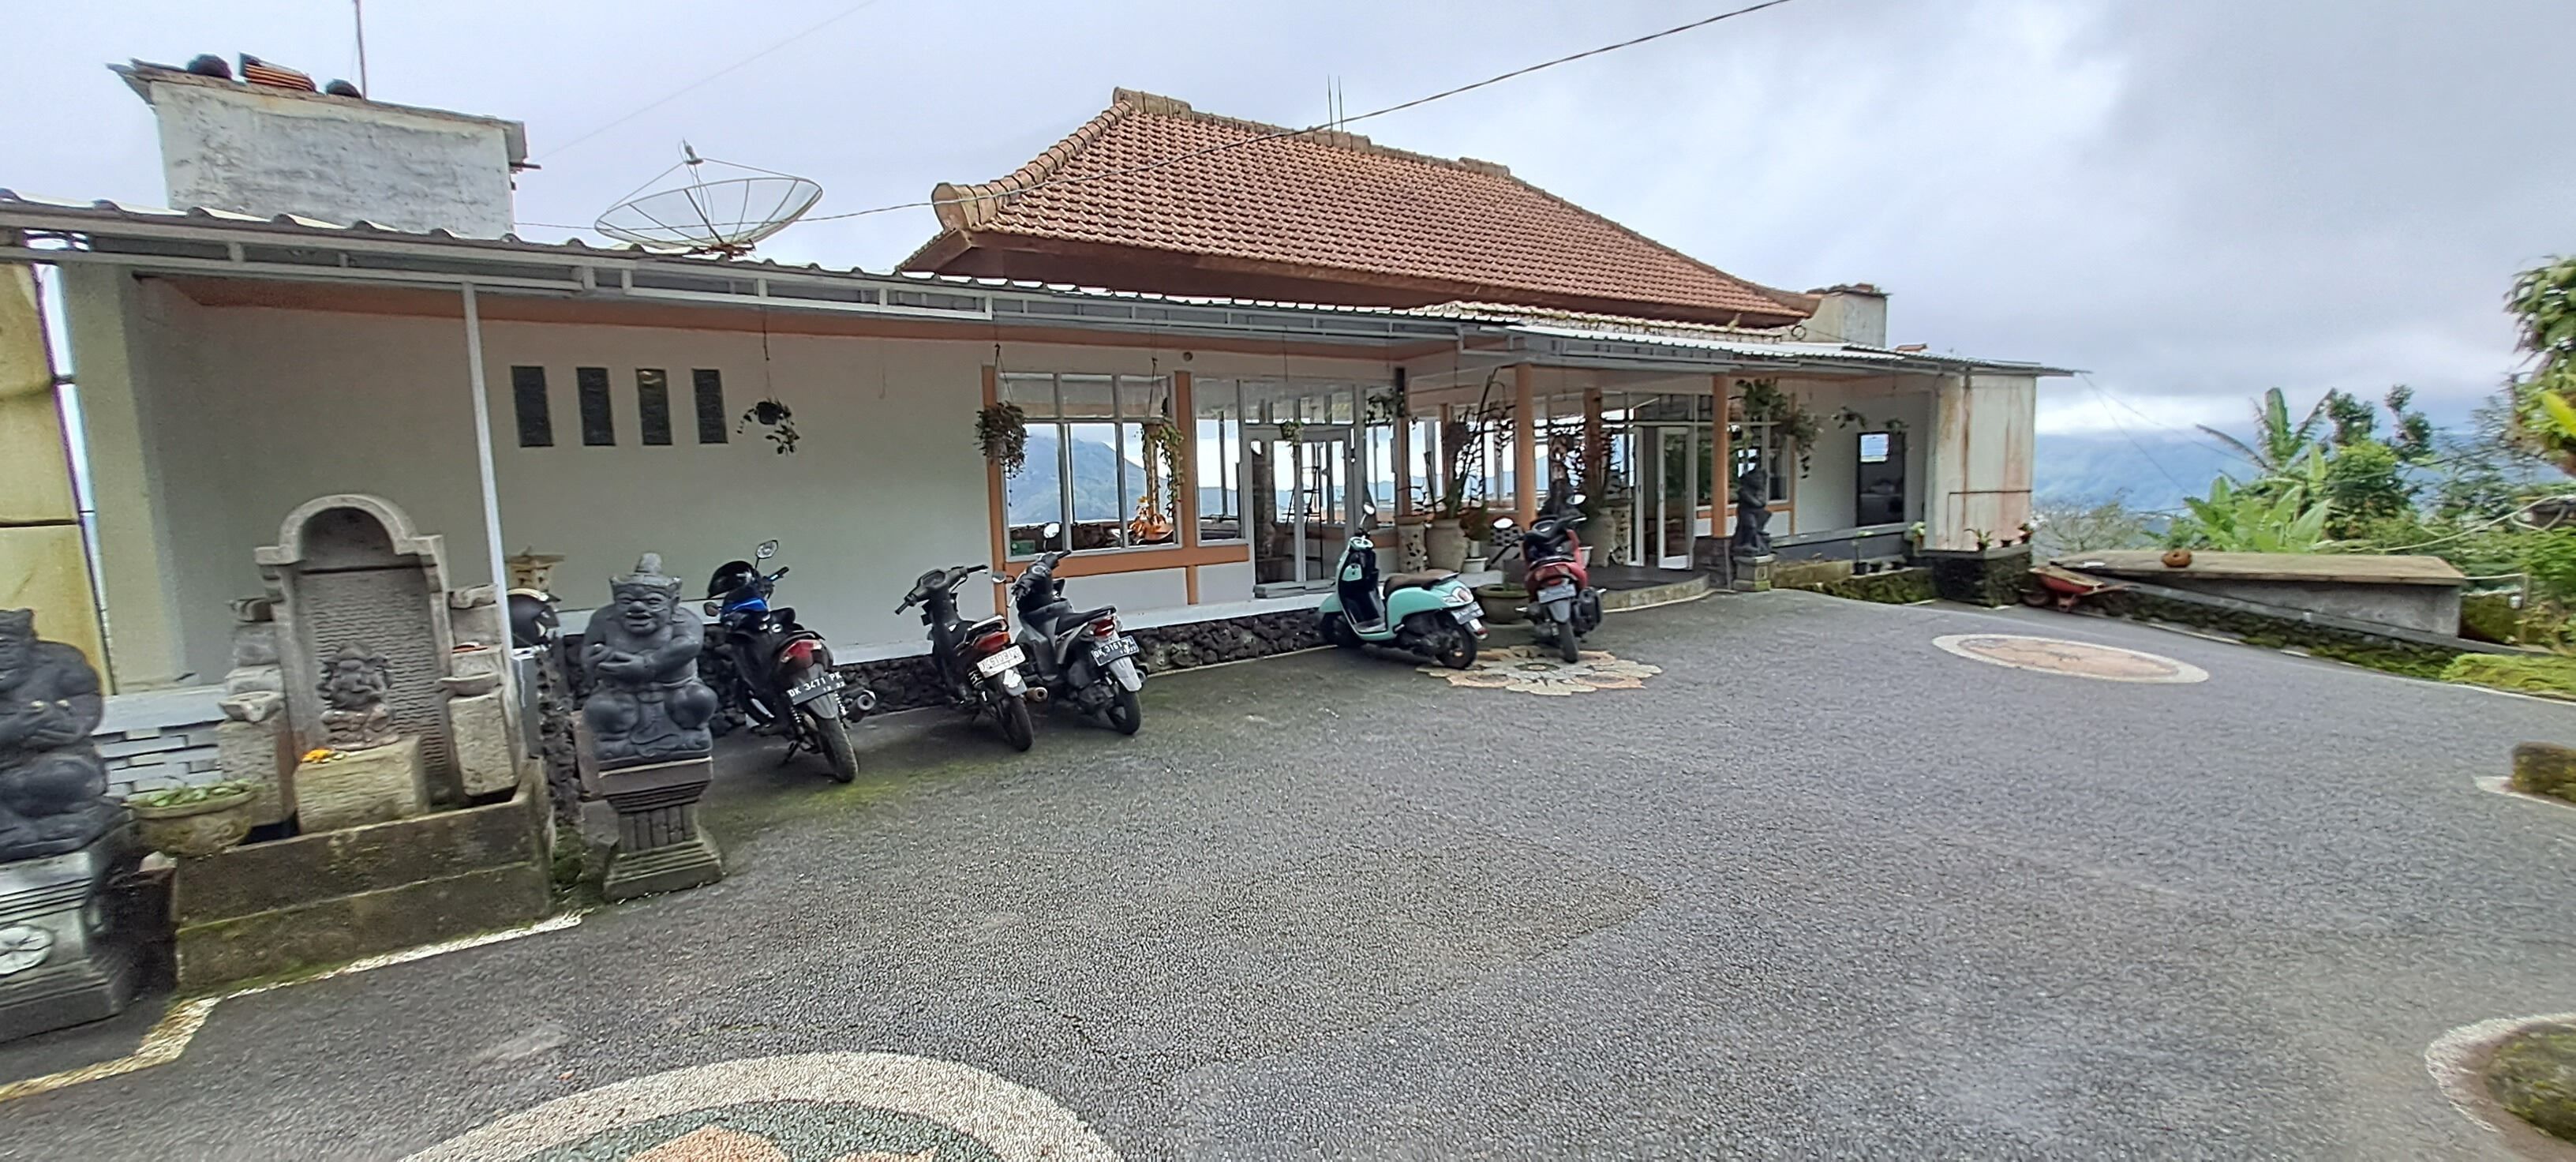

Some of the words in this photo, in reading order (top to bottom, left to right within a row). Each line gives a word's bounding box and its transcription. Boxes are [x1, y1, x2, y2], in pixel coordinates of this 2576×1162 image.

[1093, 648, 1105, 658] DK
[1105, 642, 1122, 653] 3161
[786, 687, 802, 697] DK
[803, 677, 826, 691] 3471
[829, 671, 842, 681] PK
